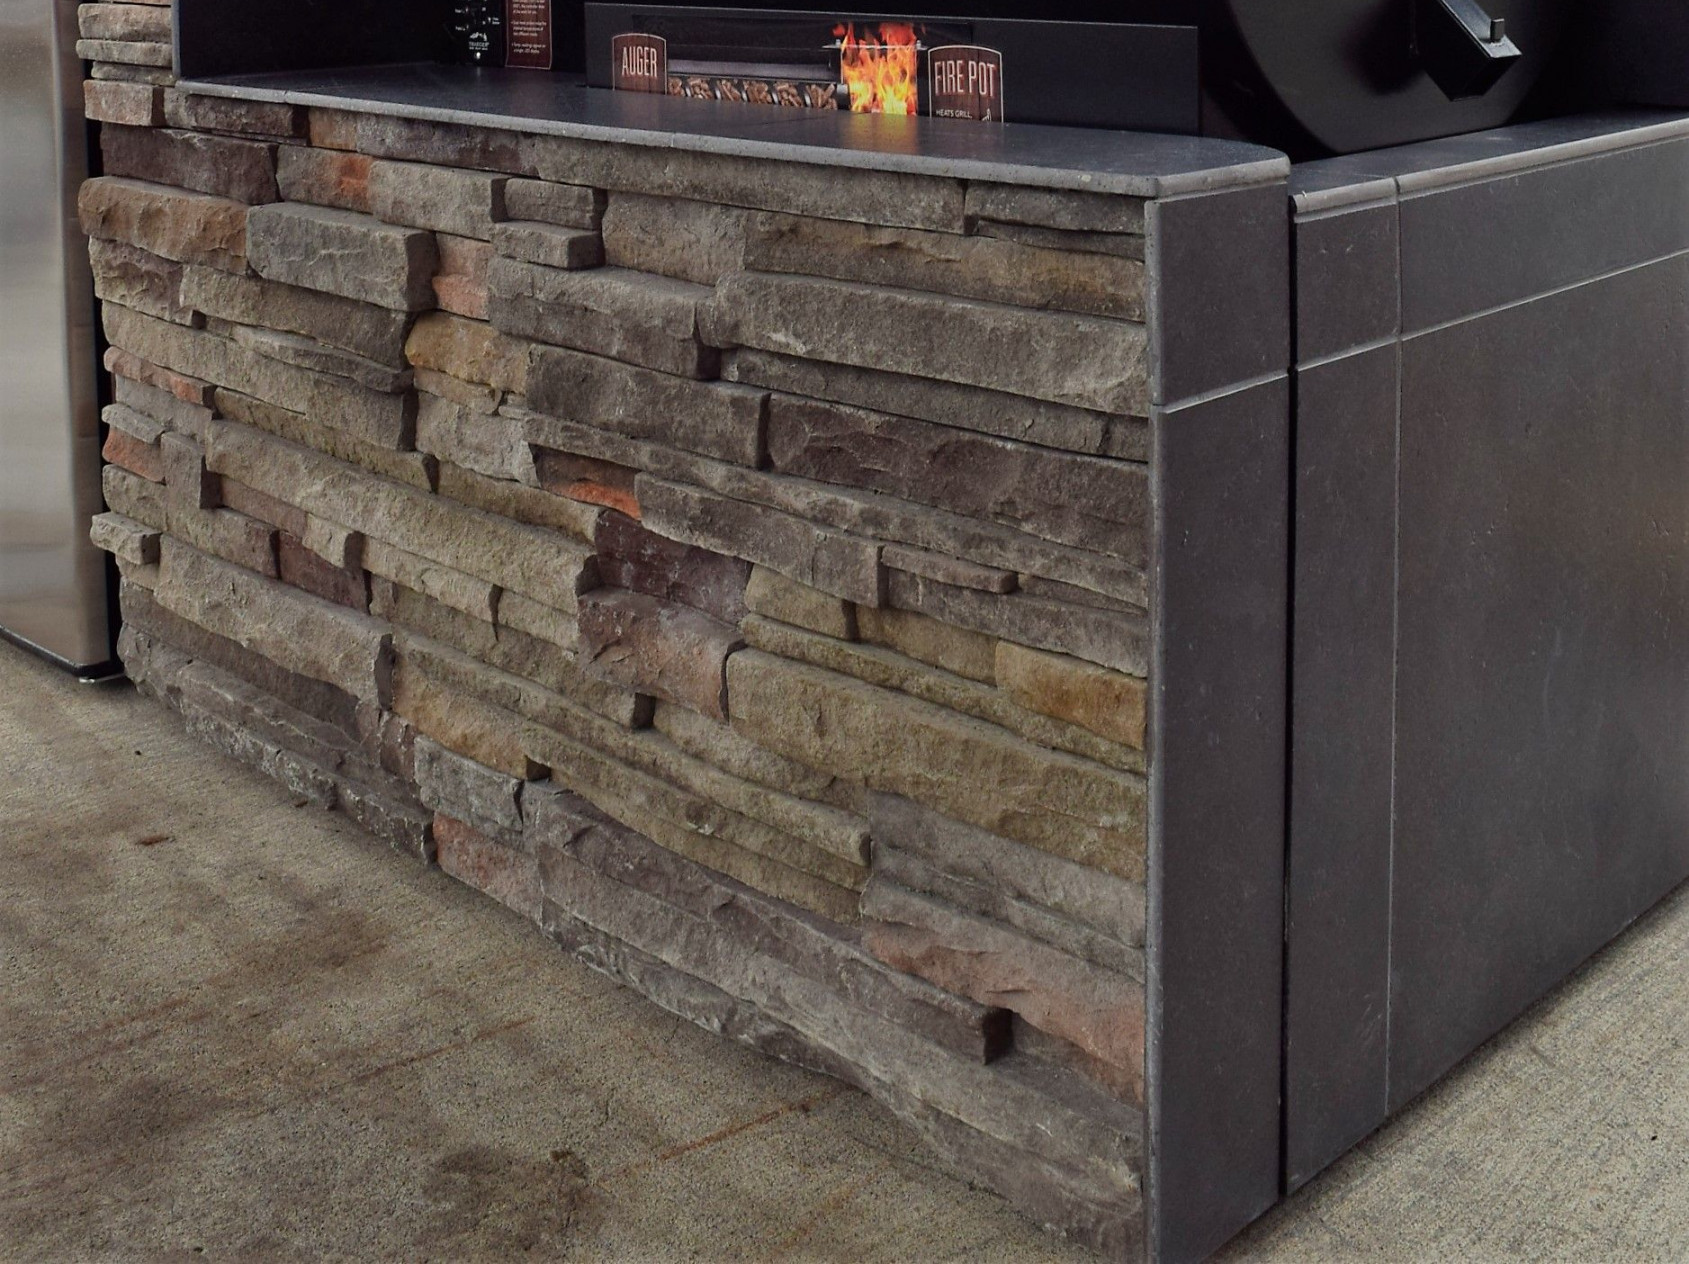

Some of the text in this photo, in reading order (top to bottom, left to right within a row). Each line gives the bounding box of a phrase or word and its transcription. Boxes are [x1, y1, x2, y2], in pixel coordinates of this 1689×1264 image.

[621, 46, 658, 79] AUGER
[934, 59, 996, 98] FIRE POT
[935, 109, 954, 119] HEATS
